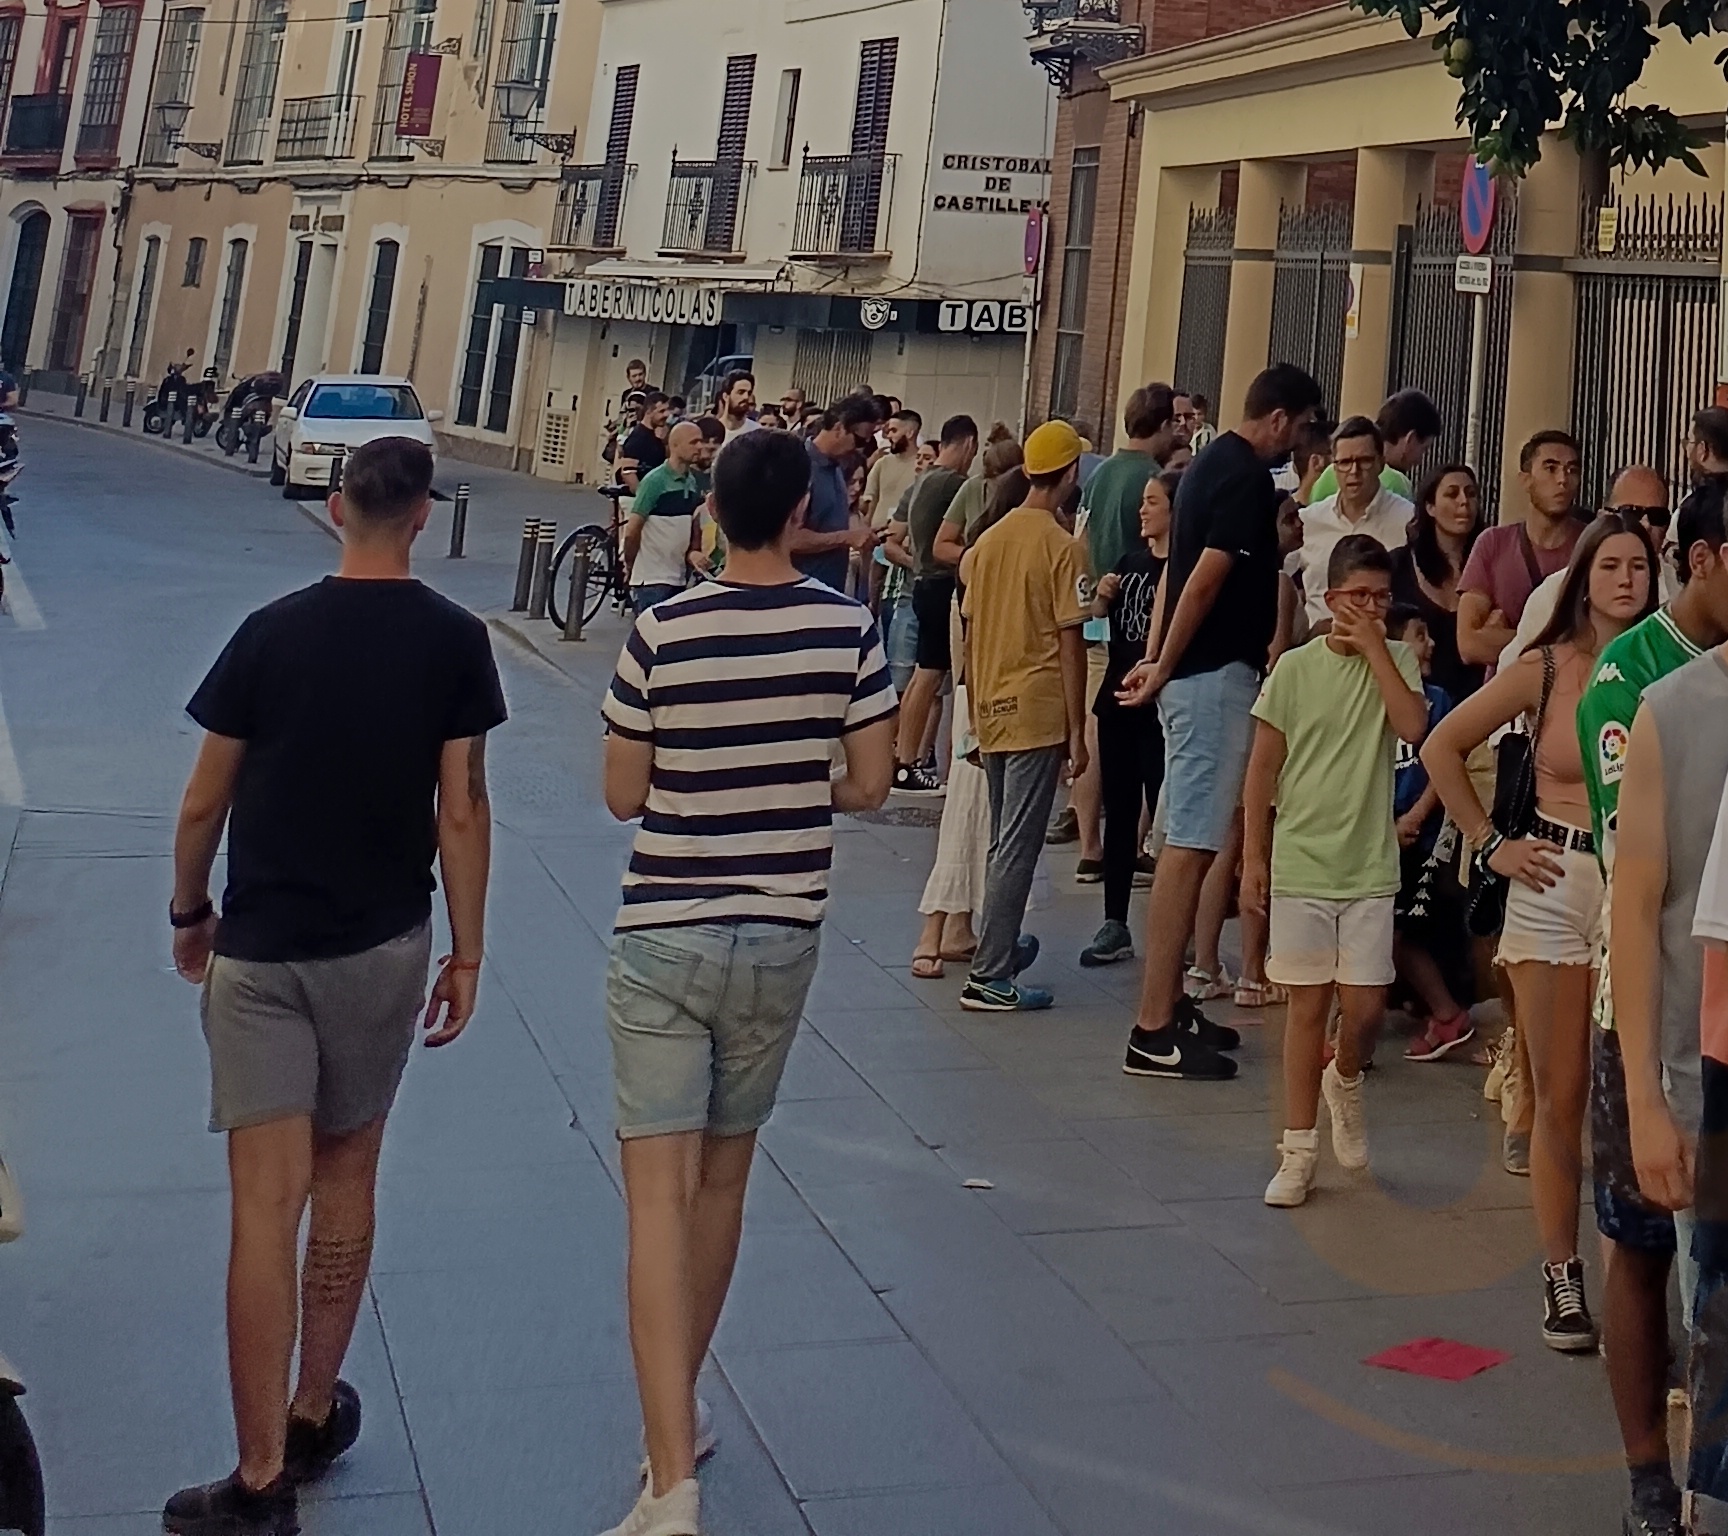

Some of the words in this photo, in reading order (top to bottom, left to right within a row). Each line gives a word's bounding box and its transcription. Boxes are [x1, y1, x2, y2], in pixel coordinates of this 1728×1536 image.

[400, 96, 412, 127] HOTEL
[943, 155, 1052, 174] CRISTOBAL
[985, 176, 1011, 191] DE
[934, 195, 1050, 215] CASTILLEO
[565, 283, 716, 322] TABERNICOLAS
